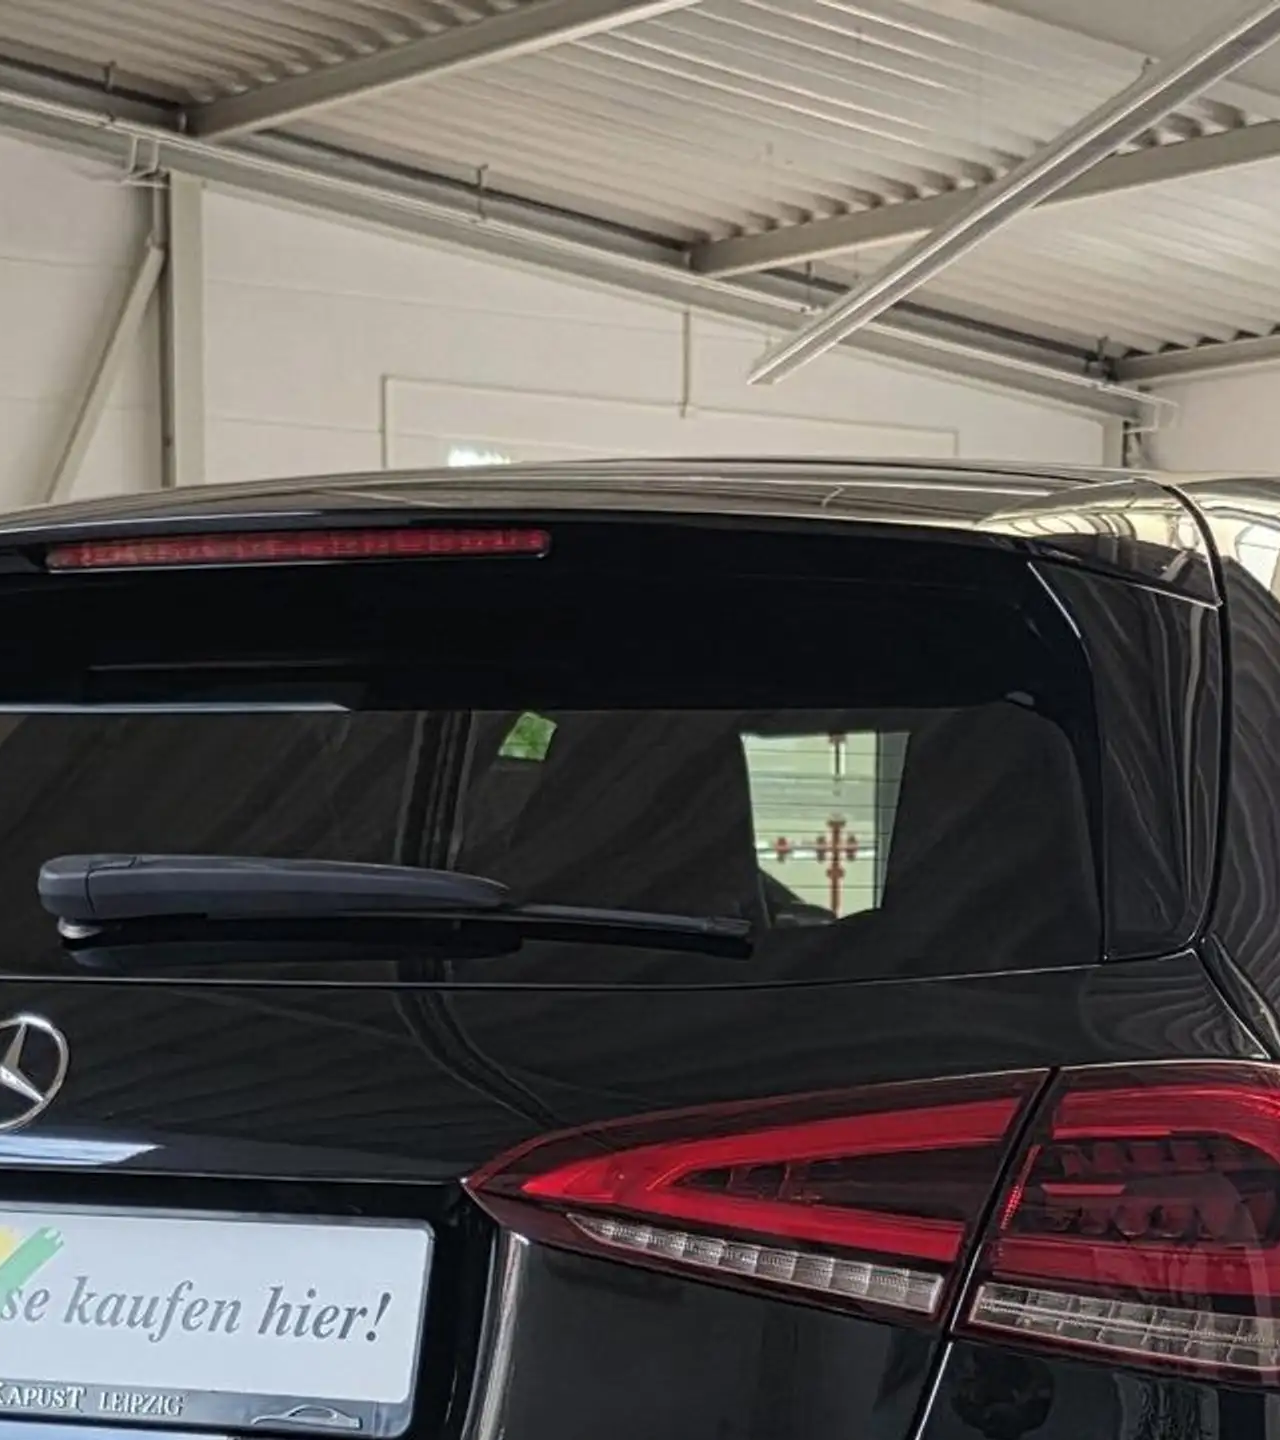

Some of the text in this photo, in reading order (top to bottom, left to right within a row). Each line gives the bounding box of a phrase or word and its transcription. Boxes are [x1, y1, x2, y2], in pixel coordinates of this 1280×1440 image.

[63, 1275, 243, 1344] kaufen
[257, 1284, 392, 1343] hier!
[98, 1390, 187, 1417] LEIPZIG
